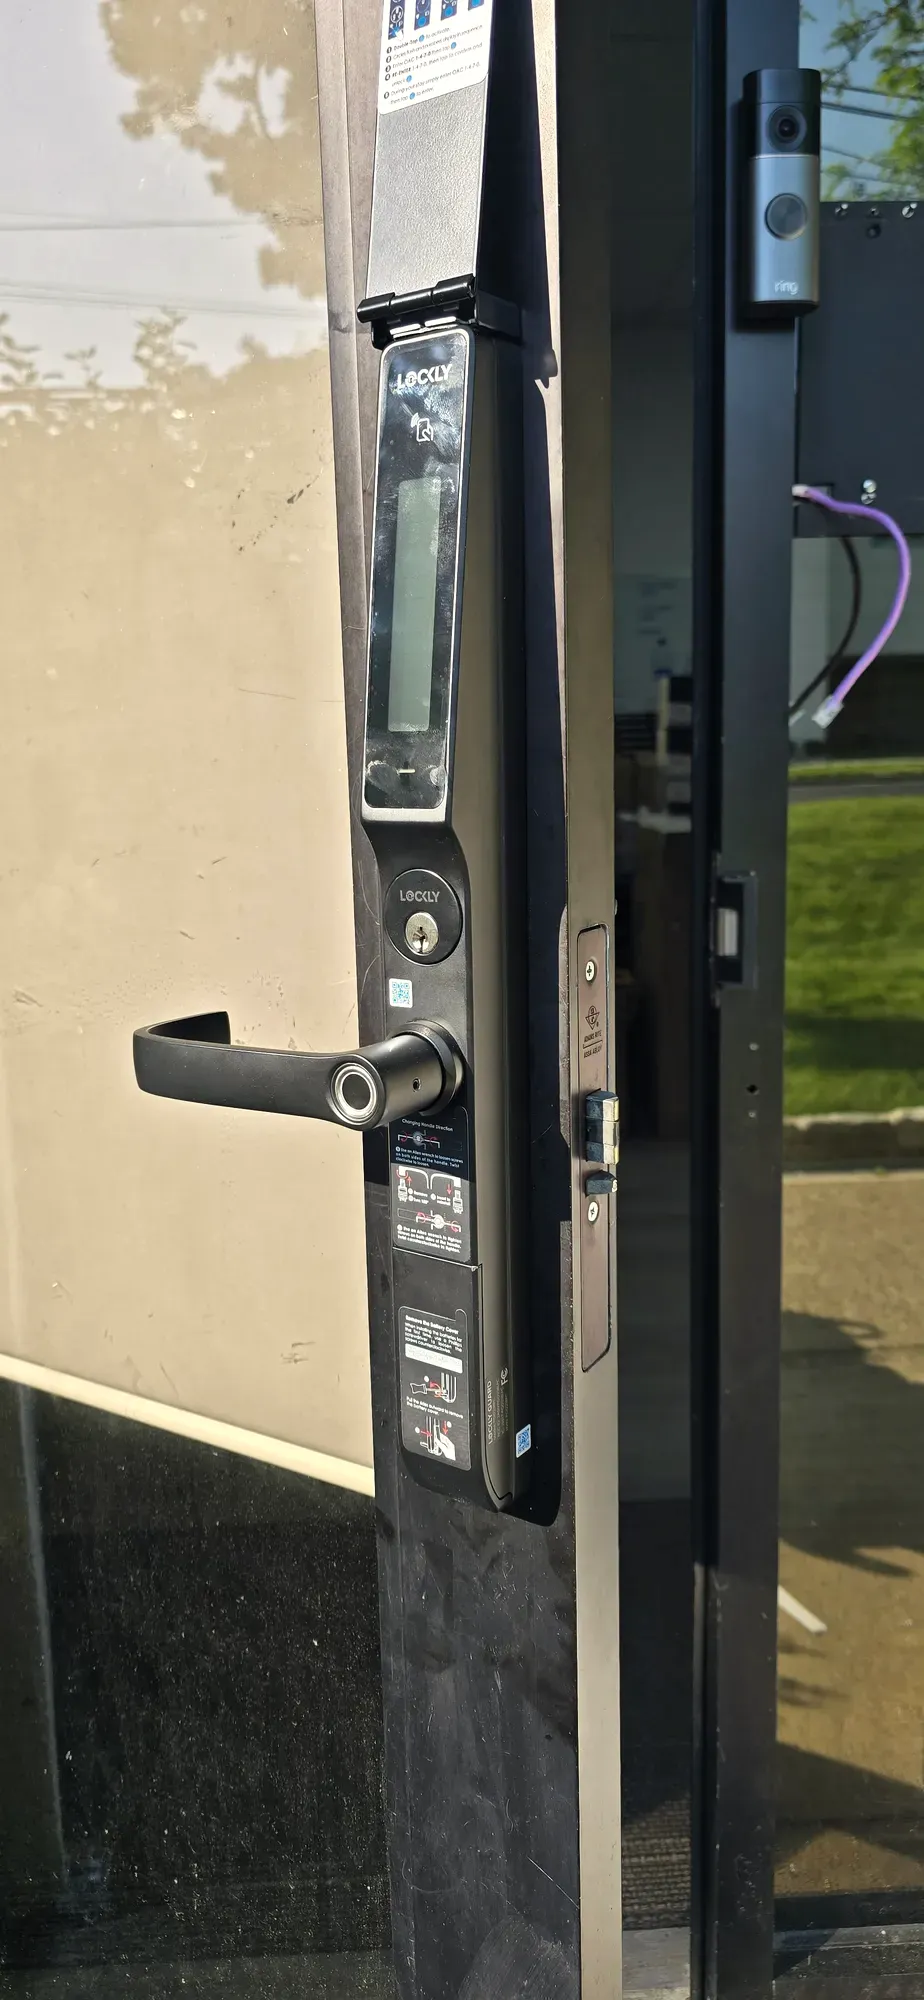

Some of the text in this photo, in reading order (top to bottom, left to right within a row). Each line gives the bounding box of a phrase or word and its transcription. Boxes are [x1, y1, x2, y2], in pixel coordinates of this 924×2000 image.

[774, 280, 799, 296] ring
[397, 364, 453, 390] LOCKLY
[400, 890, 440, 902] LOCKLY
[445, 1326, 458, 1335] Cover
